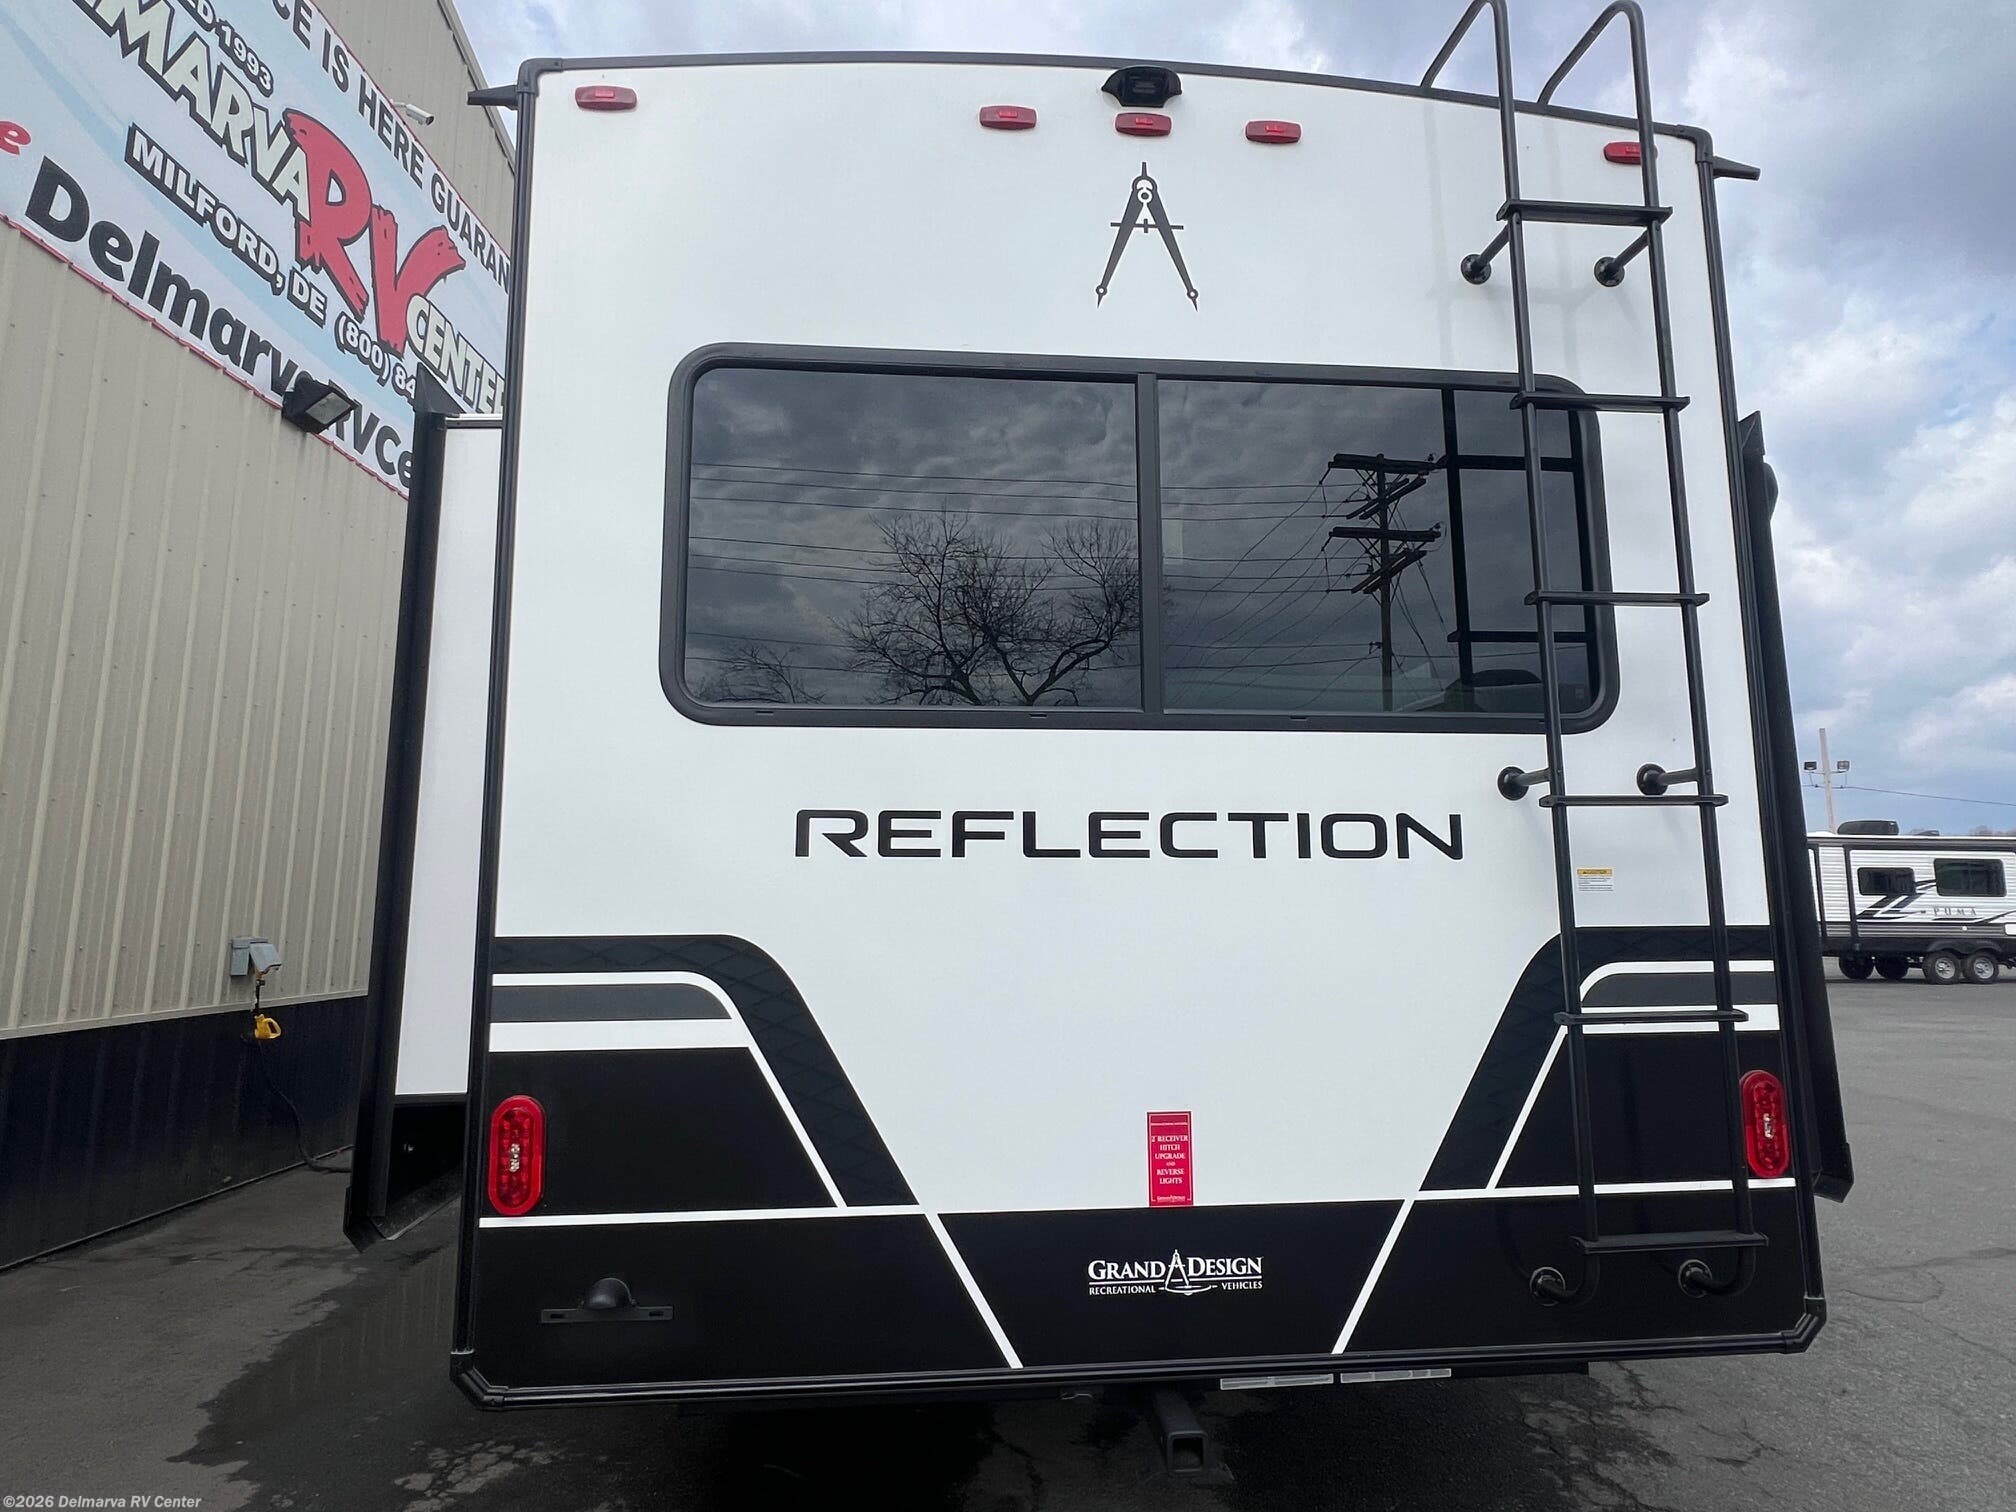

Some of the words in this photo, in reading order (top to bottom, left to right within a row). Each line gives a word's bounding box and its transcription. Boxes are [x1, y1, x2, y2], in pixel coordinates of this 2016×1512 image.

[219, 22, 274, 96] 1993
[74, 0, 311, 223] MARVA
[283, 108, 466, 360] RV
[322, 27, 350, 92] IS
[358, 75, 425, 190] HERE
[431, 173, 510, 294] GUARAN
[127, 125, 285, 295] MILFORD,
[289, 268, 327, 327] DE
[336, 311, 391, 385] (800)
[795, 810, 1463, 859] REFLECTION
[1088, 1260, 1166, 1280] GRAND
[1187, 1257, 1263, 1276] DESIGN
[1089, 1285, 1156, 1295] RECREATIONAL
[1221, 1281, 1263, 1290] VEHICLES
